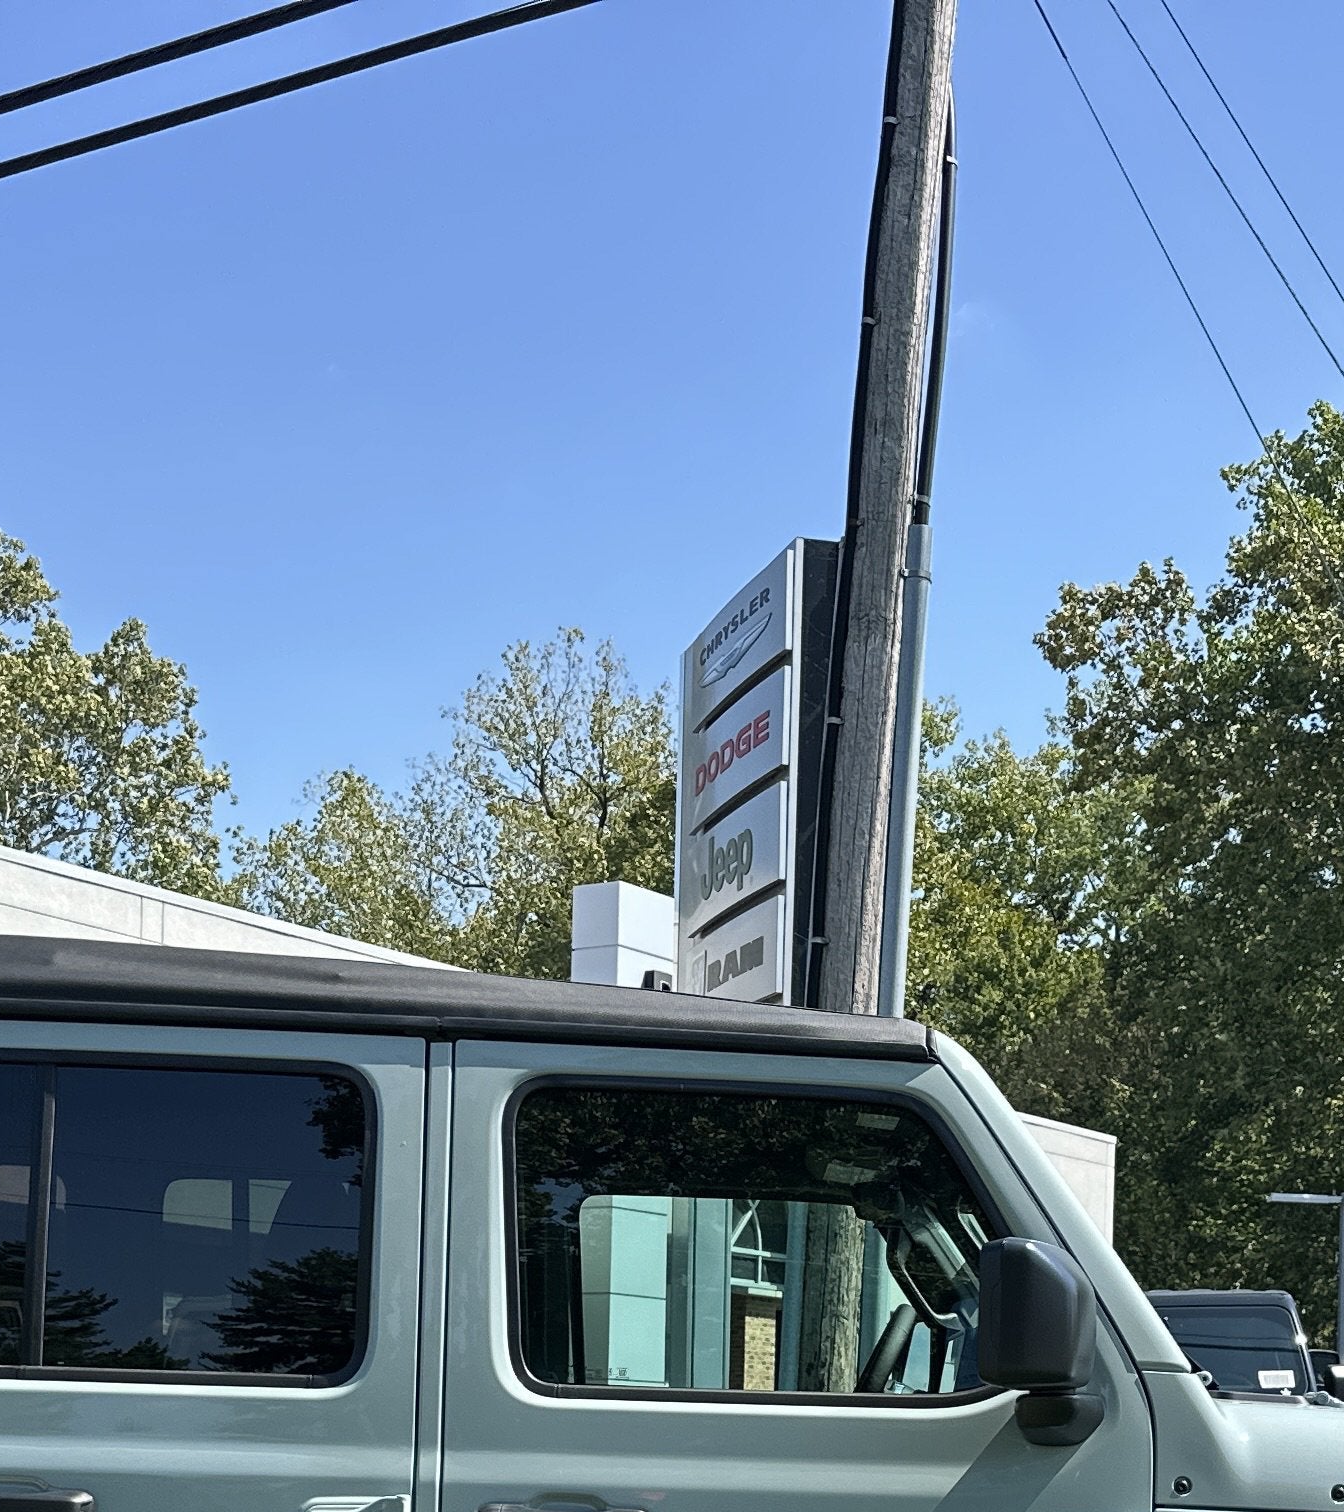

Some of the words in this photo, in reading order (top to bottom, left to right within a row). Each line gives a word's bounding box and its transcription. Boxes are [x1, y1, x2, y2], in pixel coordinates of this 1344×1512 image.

[699, 587, 771, 666] CHRYSLER
[694, 710, 770, 796] DODGE
[700, 828, 753, 900] Jeep
[707, 936, 764, 992] RAM
